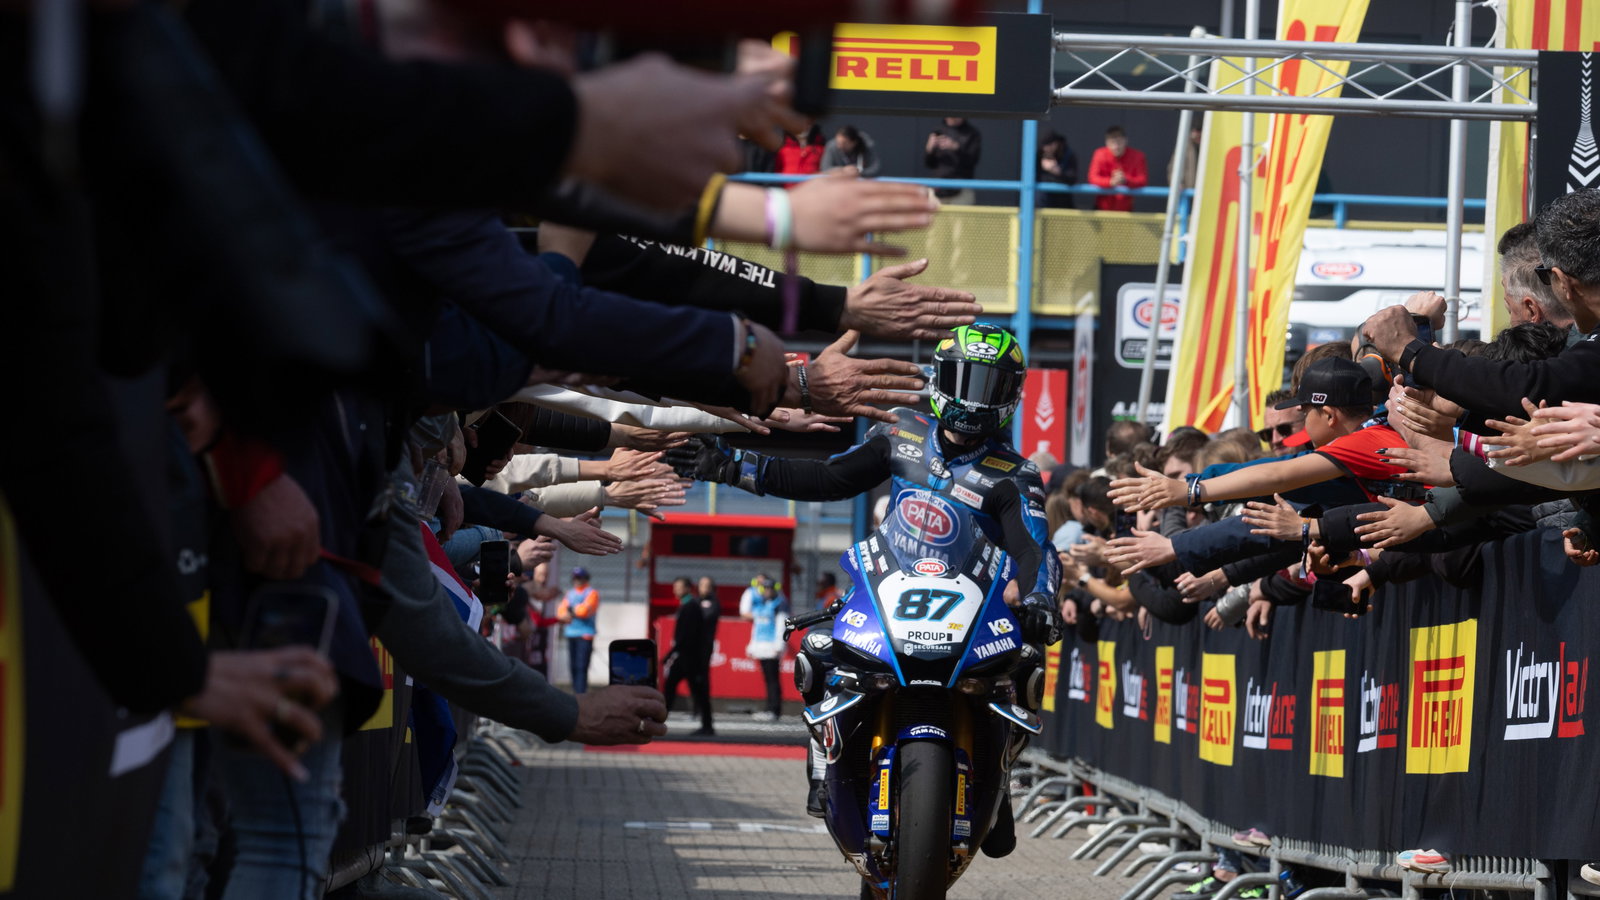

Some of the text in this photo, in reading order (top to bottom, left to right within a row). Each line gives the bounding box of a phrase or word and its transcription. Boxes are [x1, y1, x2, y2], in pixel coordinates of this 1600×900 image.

[659, 242, 776, 288] THE WALKIN
[907, 503, 944, 532] PATA
[894, 531, 950, 564] YAMAHA
[918, 564, 941, 572] PATA
[893, 588, 966, 622] 87
[842, 628, 882, 656] YAMAHA
[973, 636, 1017, 659] YAMAHA
[910, 728, 946, 738] YAMAHA
